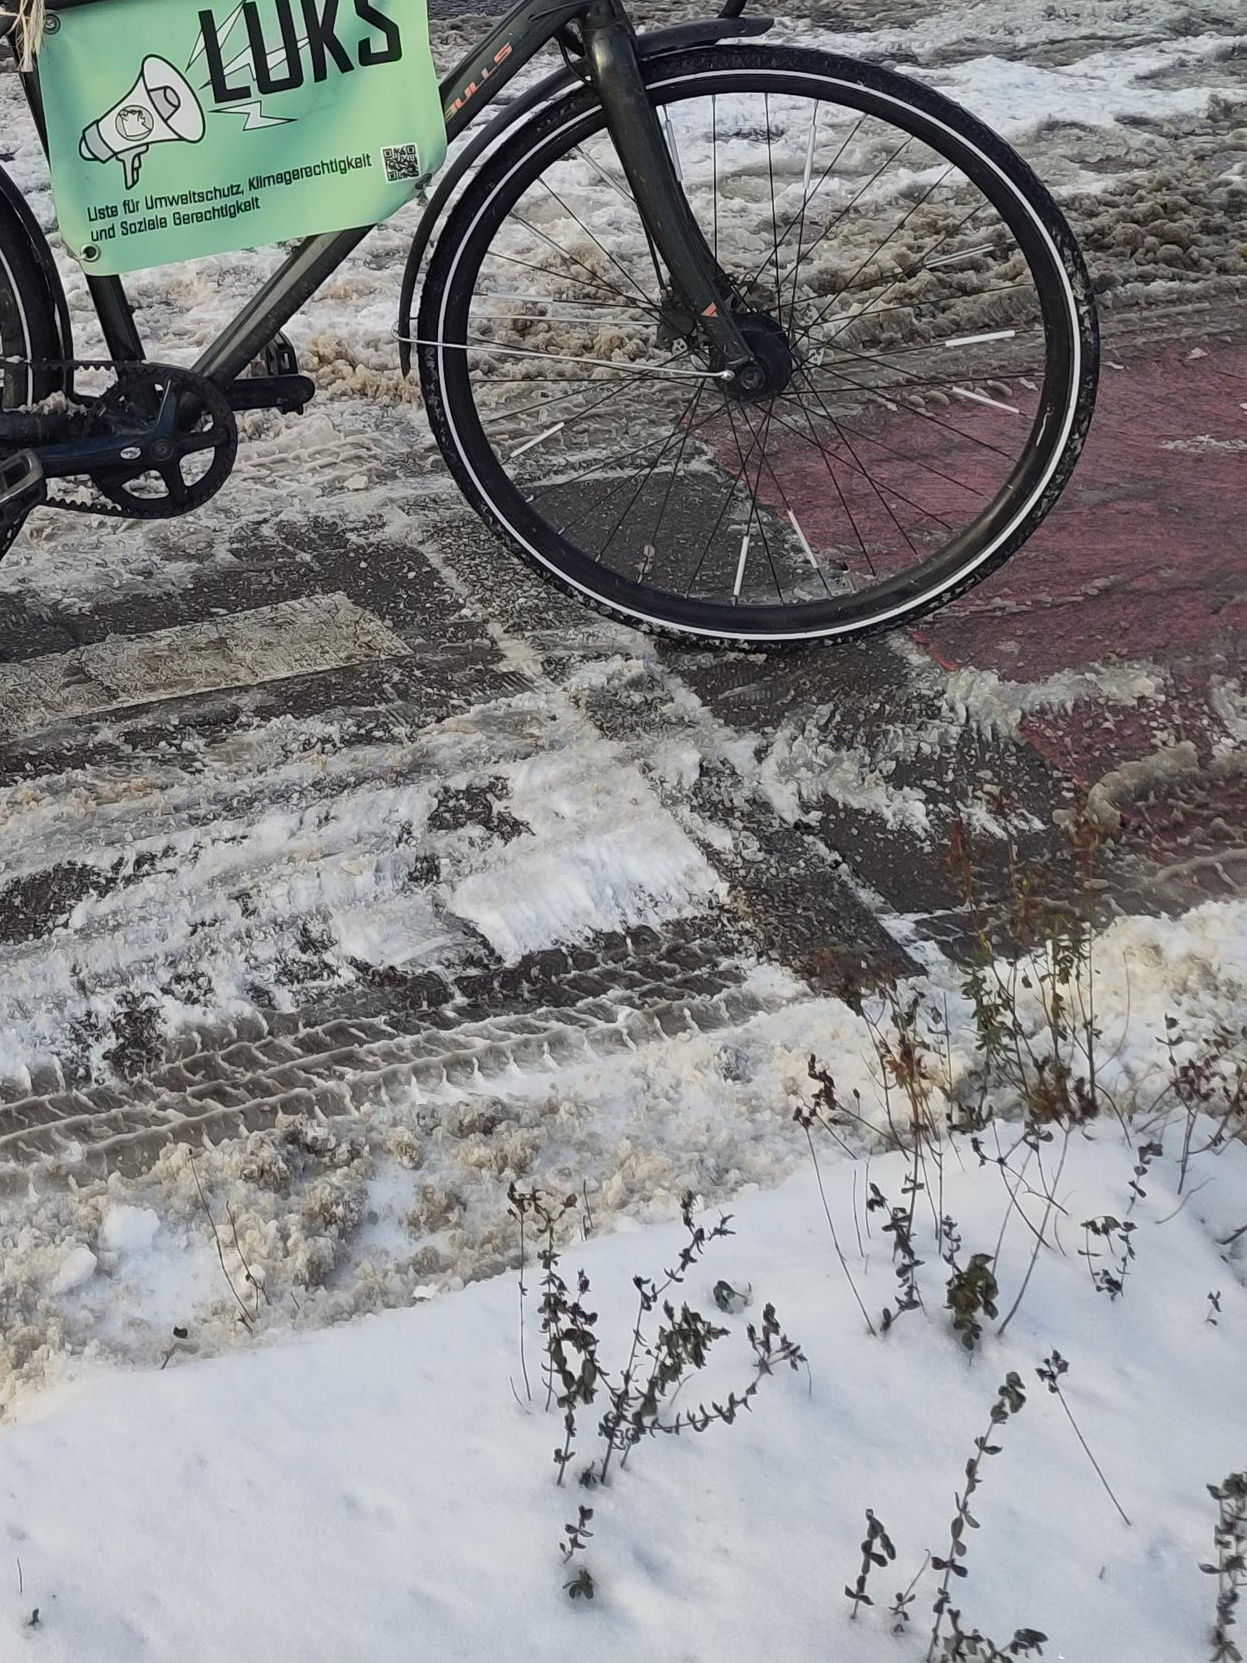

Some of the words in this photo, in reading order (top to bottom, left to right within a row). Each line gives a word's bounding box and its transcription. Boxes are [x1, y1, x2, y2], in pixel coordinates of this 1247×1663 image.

[87, 204, 119, 222] Liste
[122, 199, 140, 215] für
[144, 183, 245, 210] Umweltschutz,
[248, 152, 373, 191] Klimagerechtigkeit
[90, 222, 116, 242] und
[120, 214, 168, 236] Soziale
[172, 196, 261, 227] Gerechtigkeit
